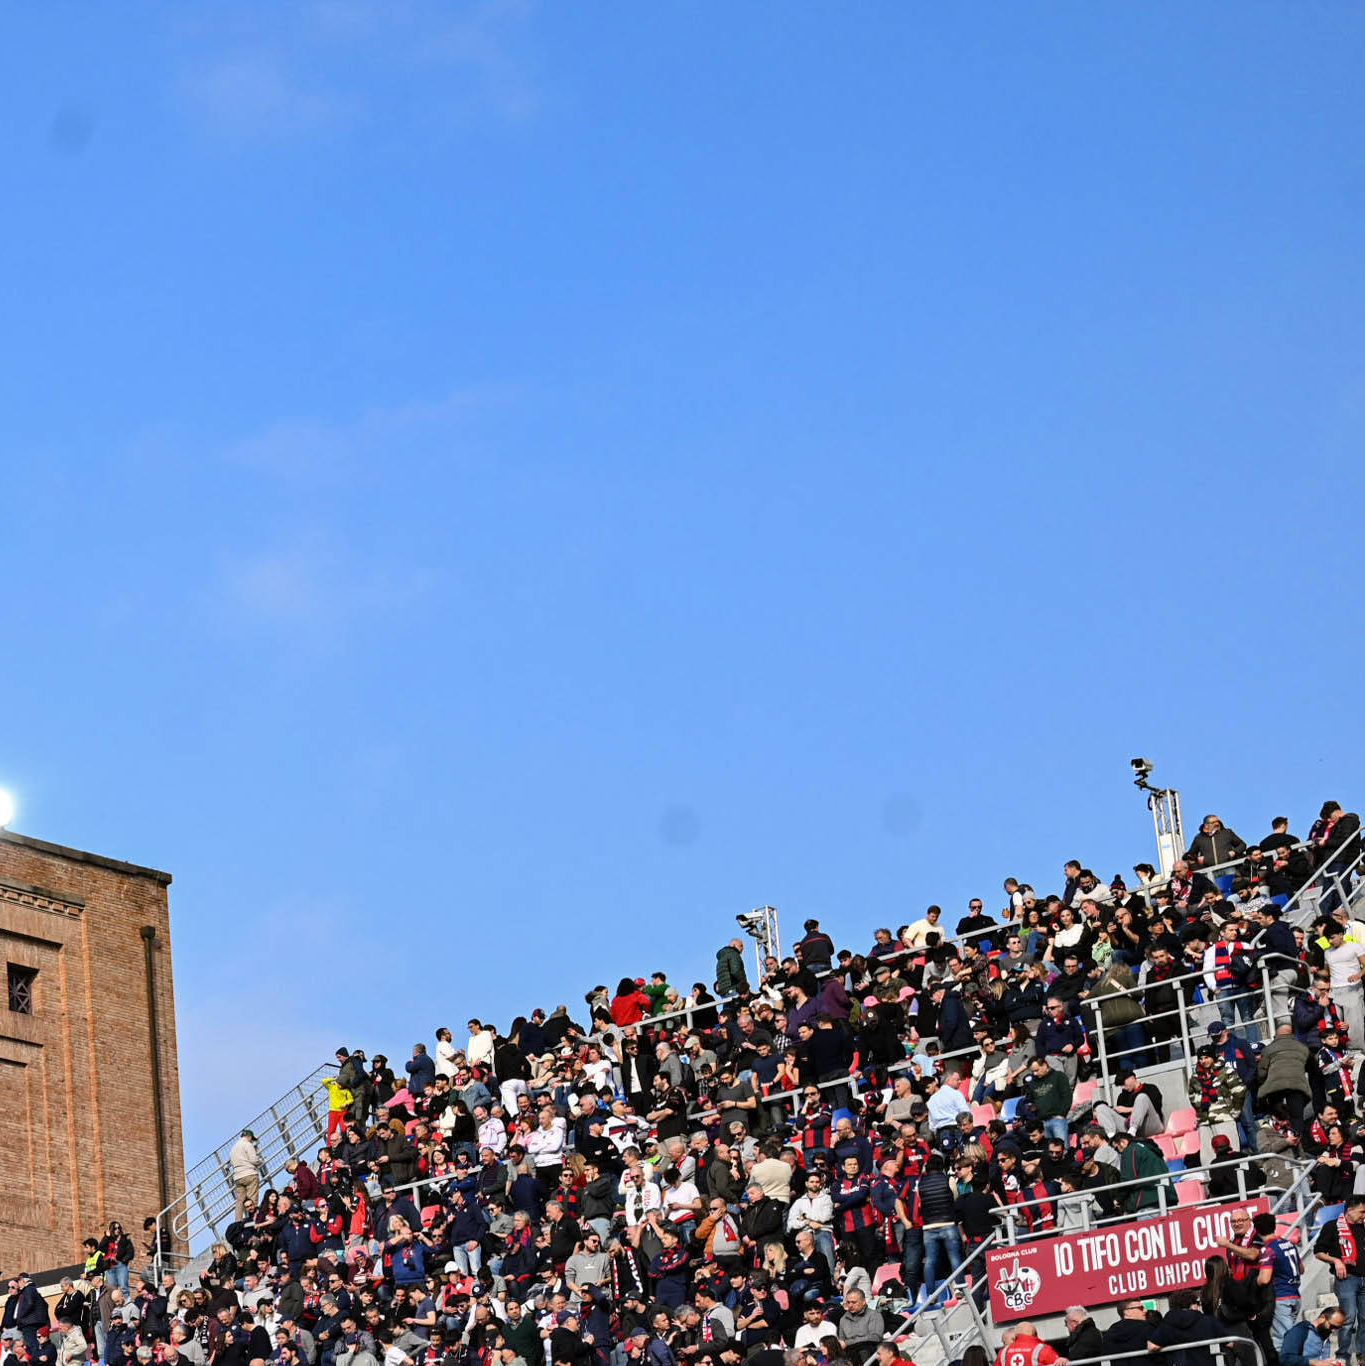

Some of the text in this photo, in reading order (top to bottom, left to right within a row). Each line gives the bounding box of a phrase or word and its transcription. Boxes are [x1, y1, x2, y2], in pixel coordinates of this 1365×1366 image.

[991, 1247, 1037, 1262] BOLOGNA CLUB
[1054, 1220, 1188, 1277] IO TIFO CON IL
[1284, 1248, 1298, 1277] 17
[1108, 1267, 1148, 1295] CLUB
